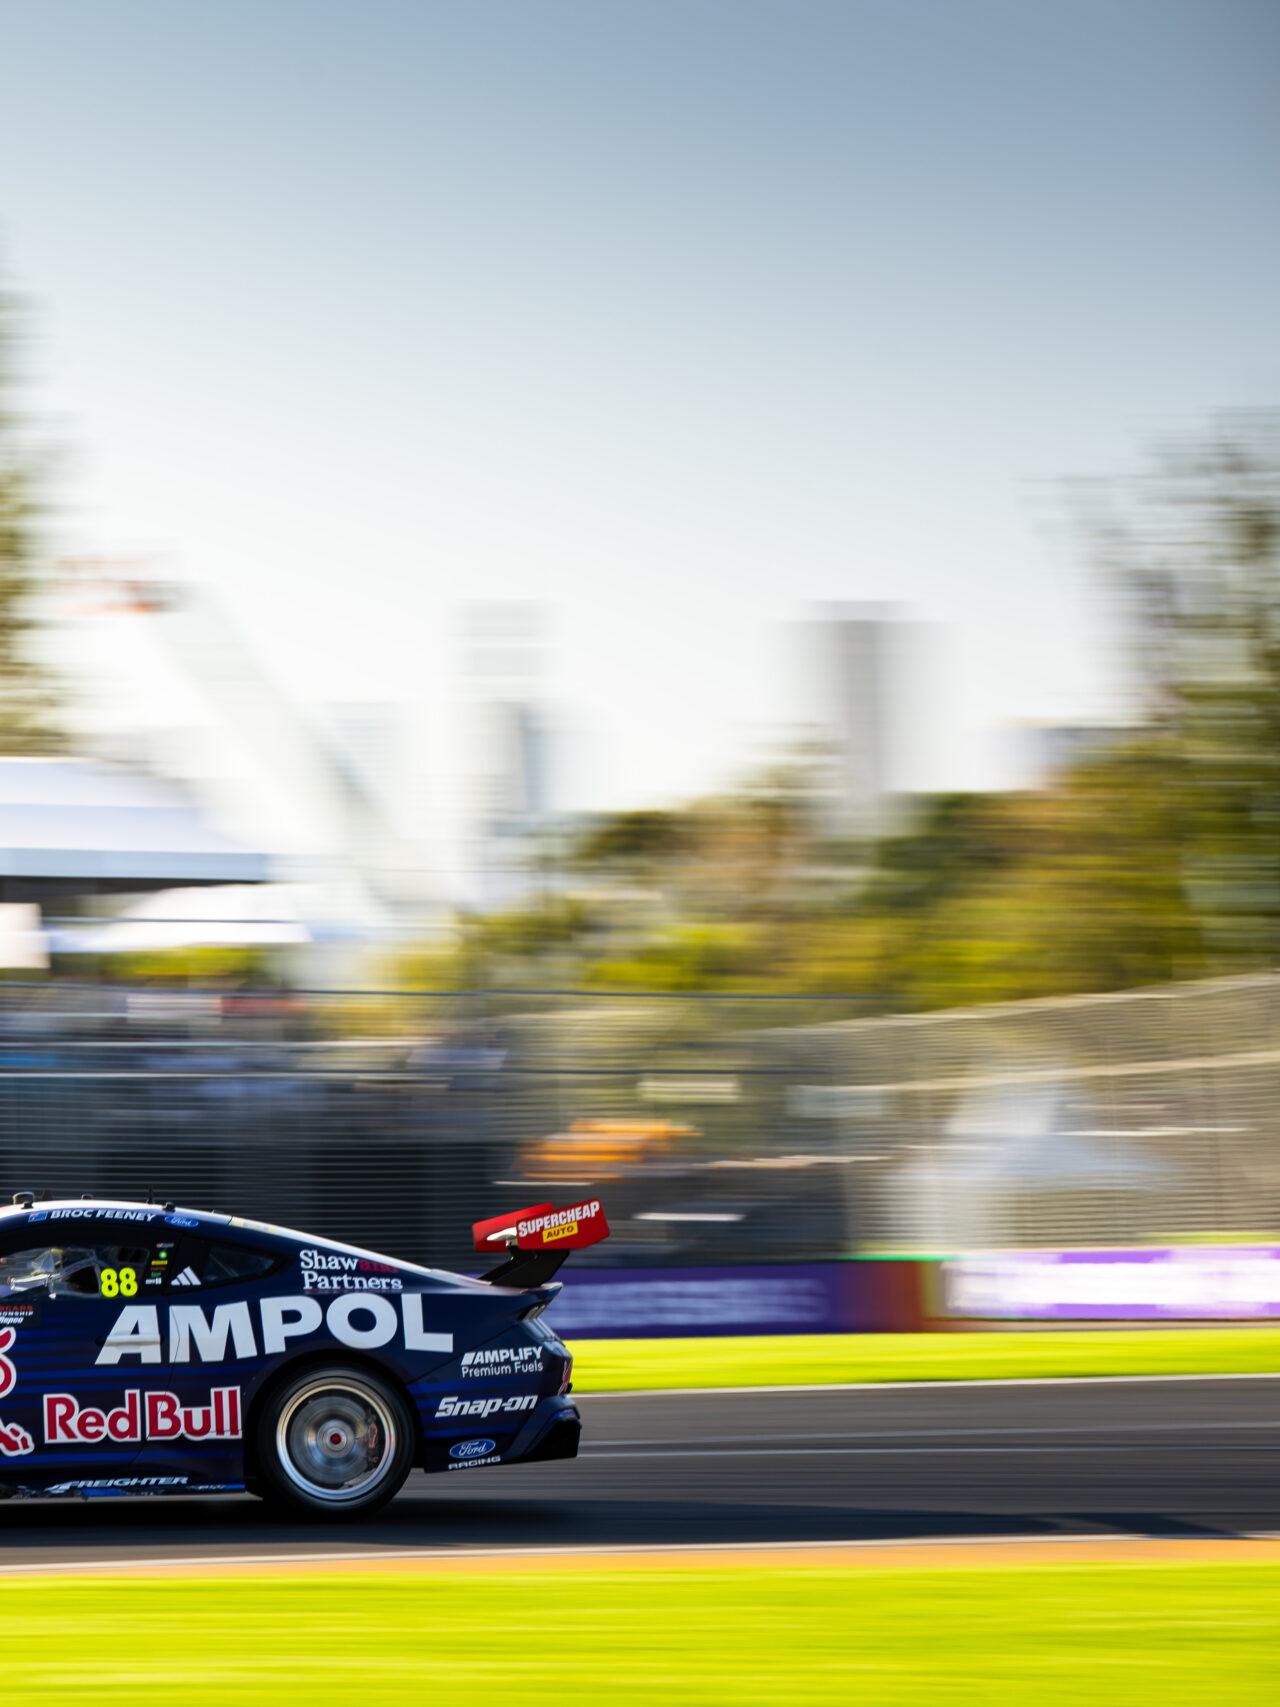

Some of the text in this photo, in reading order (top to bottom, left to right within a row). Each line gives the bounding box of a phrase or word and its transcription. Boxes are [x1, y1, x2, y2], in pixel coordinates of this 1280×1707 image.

[50, 1209, 156, 1222] BROC FEENEY
[518, 1201, 600, 1237] SUPERCHEAP
[546, 1225, 574, 1239] AUTO
[100, 1267, 138, 1298] 88
[301, 1270, 403, 1290] Partners
[94, 1292, 454, 1365] AMPOL
[473, 1346, 543, 1366] AMPLIFY
[462, 1360, 544, 1378] Premium Fuels
[434, 1395, 539, 1418] Snap-on
[448, 1455, 502, 1470] RACING
